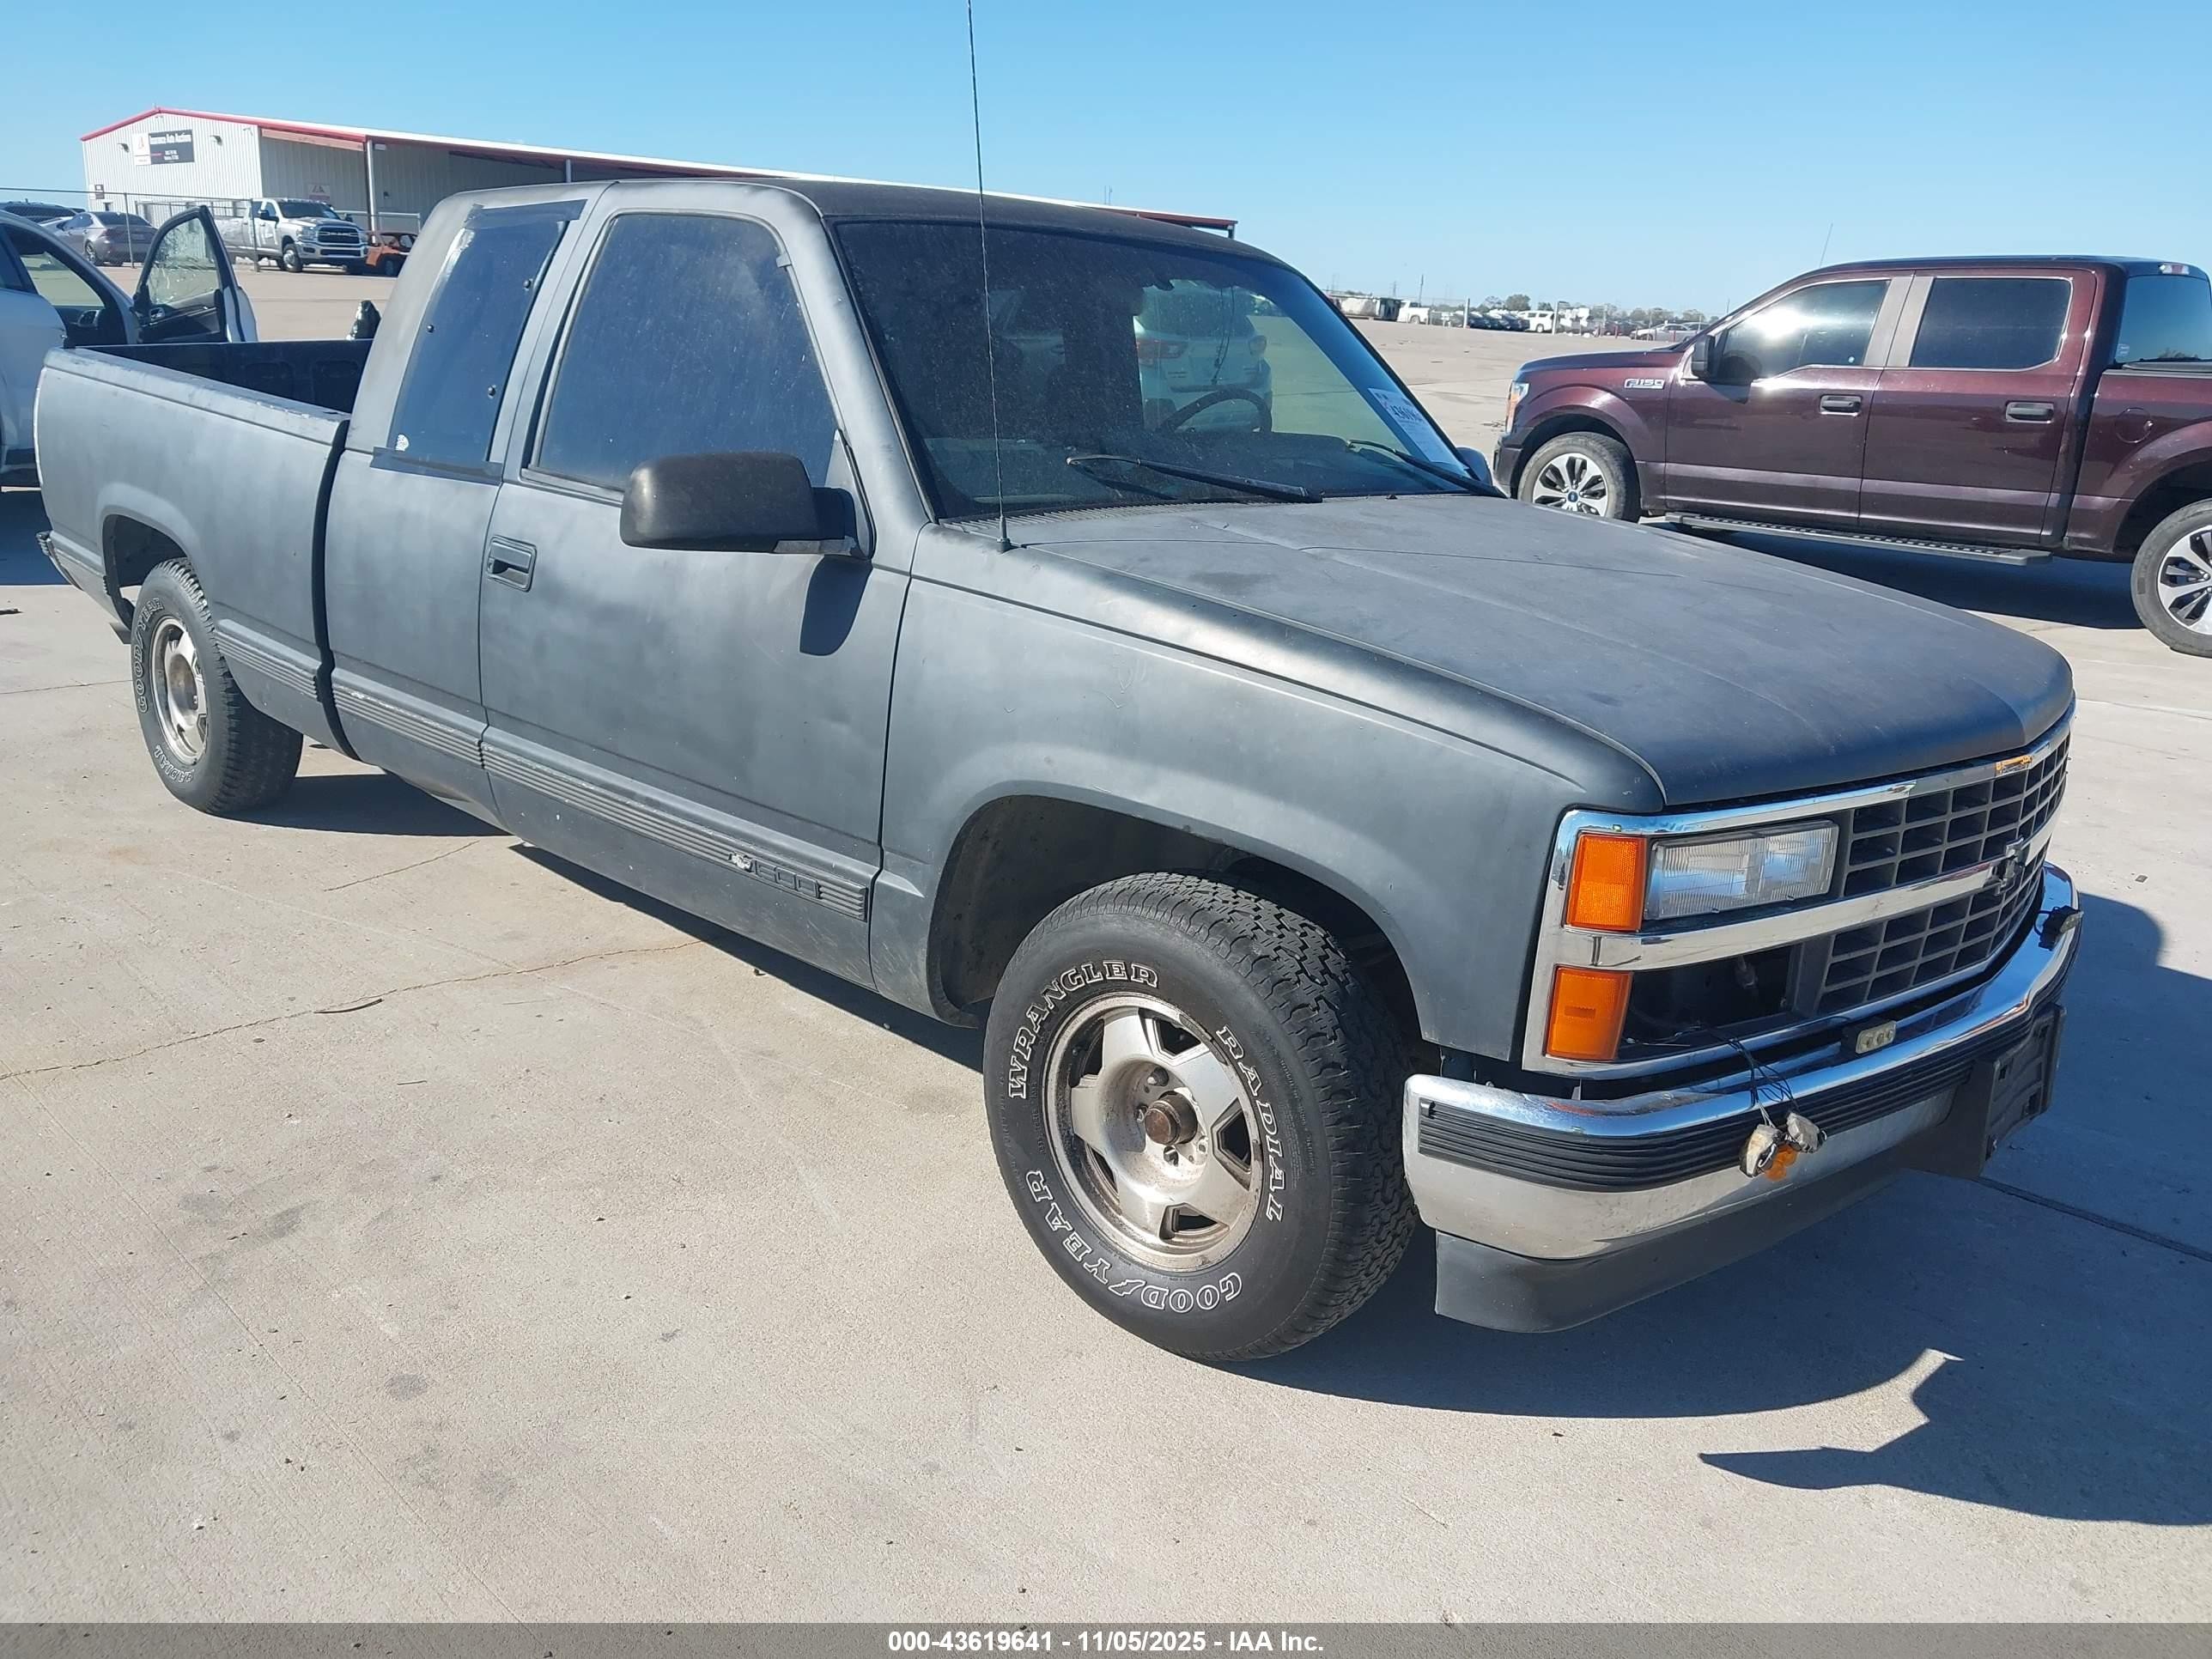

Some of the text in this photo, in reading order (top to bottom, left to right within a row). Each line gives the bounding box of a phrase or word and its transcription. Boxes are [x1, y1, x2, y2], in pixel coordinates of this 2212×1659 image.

[1006, 959, 1159, 1100] WRANGLER
[1215, 1024, 1286, 1222] RADIAL
[1024, 1169, 1243, 1314] GOODYEAR
